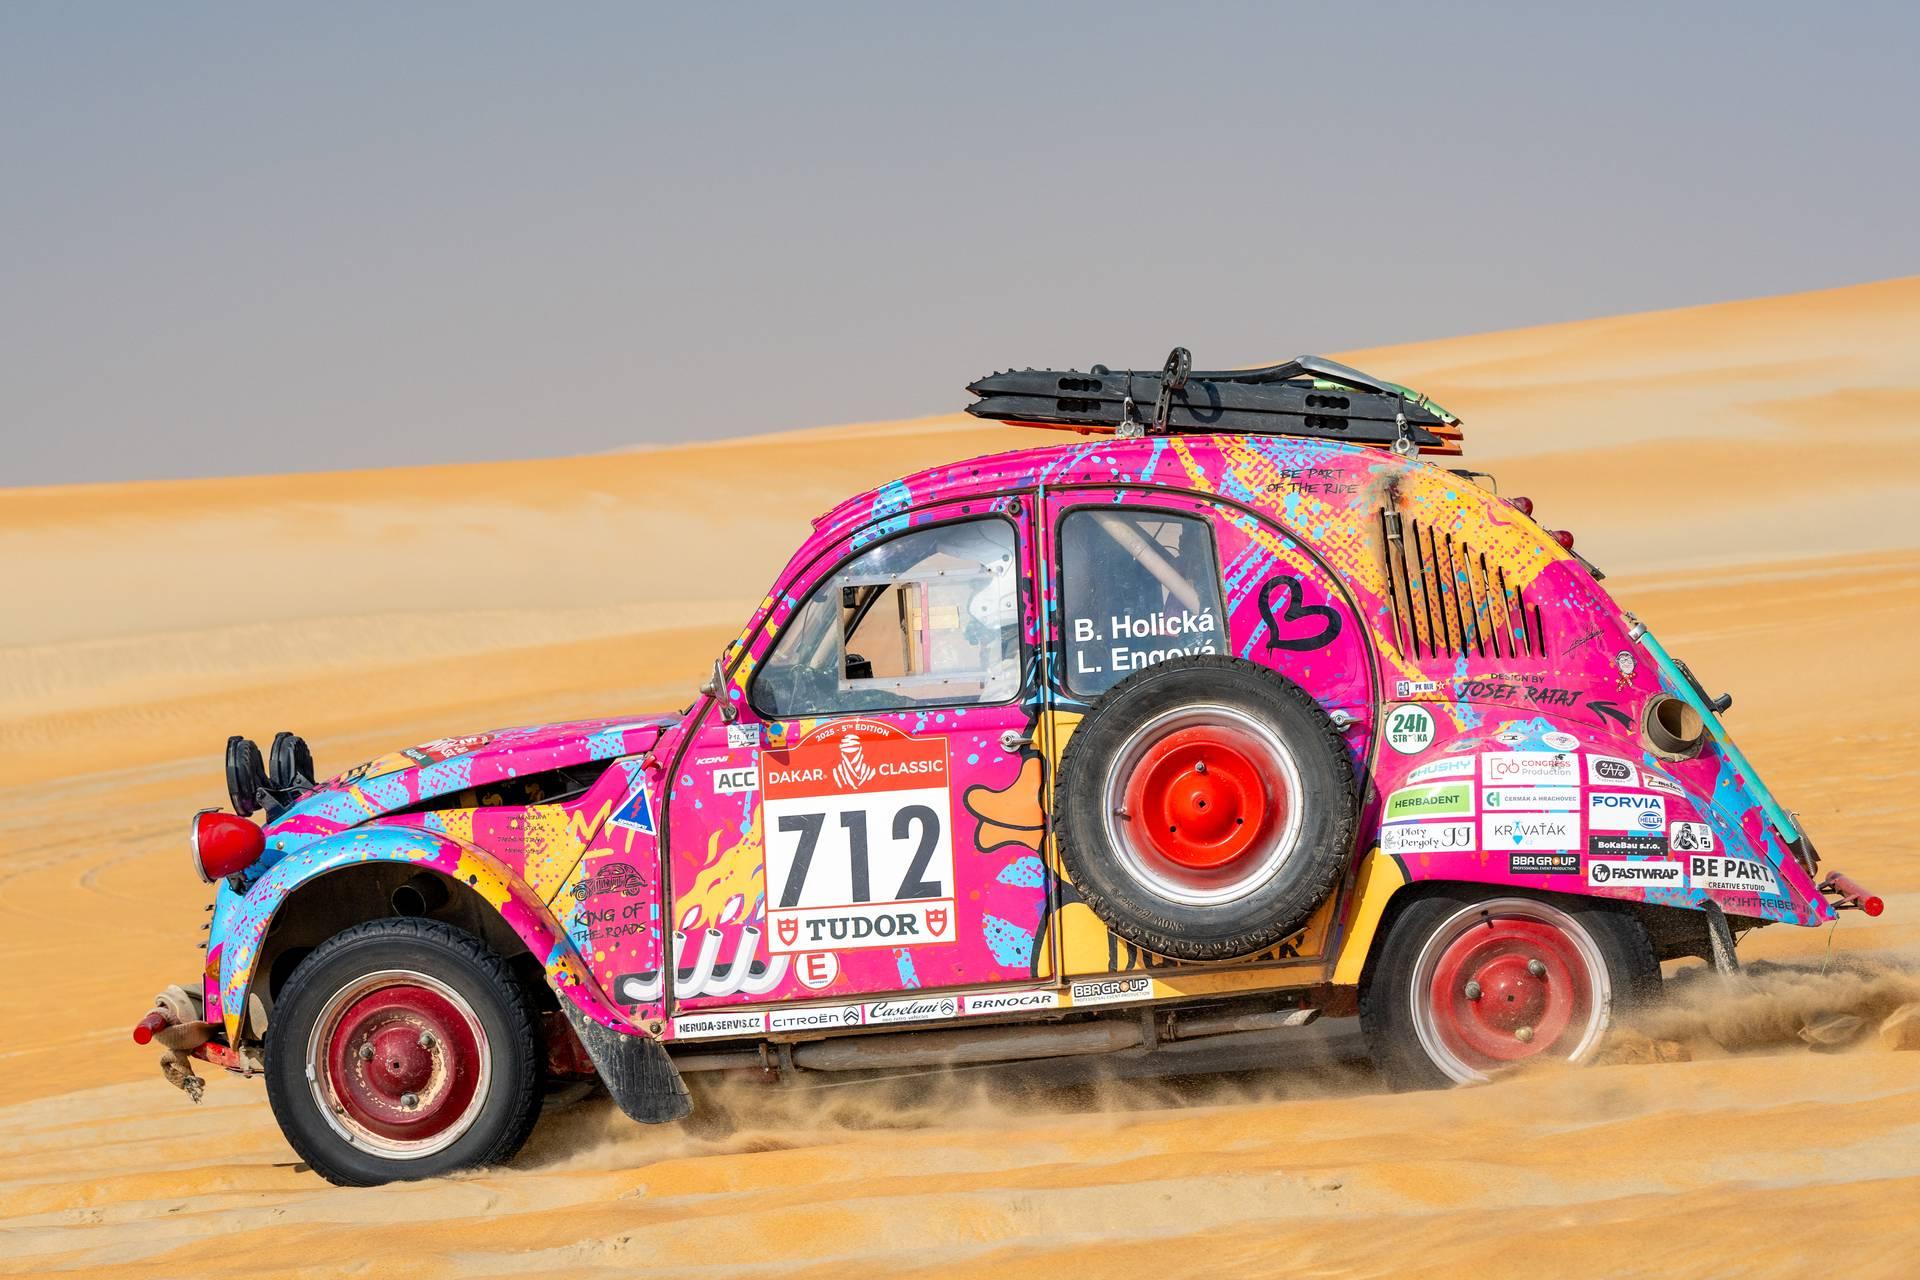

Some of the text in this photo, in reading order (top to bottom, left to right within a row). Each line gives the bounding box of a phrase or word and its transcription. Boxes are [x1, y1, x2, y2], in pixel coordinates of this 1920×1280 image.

[1280, 467, 1345, 480] BE PART
[1266, 482, 1361, 494] OF THE RIDE
[1074, 607, 1215, 642] B. Holická
[1077, 650, 1102, 674] L.
[1490, 673, 1545, 684] DESIGN BY
[1457, 680, 1584, 707] JOSEF RATAJ
[1393, 714, 1428, 733] 24h
[815, 728, 835, 742] 2025
[855, 723, 890, 737] EDITION
[769, 759, 944, 784] DAKAR CLASSIC
[1417, 760, 1471, 776] HUSKY
[1521, 760, 1571, 768] CONGRESS
[1521, 768, 1572, 776] Production
[718, 771, 756, 789] ACC
[1395, 795, 1460, 809] HERBADENT
[1592, 796, 1662, 809] FORVIA
[1598, 841, 1638, 849] BoKaBau
[778, 804, 942, 908] 712
[1612, 868, 1679, 880] FASTWRAP
[1692, 858, 1775, 883] BE PART.
[1708, 881, 1766, 891] CREATIVE STUDIO
[574, 901, 647, 927] KING OF
[606, 921, 647, 938] ROADS
[806, 913, 919, 941] TUDOR
[806, 953, 828, 981] E
[870, 1001, 939, 1018] Caselani
[972, 995, 1052, 1009] BRNOCAR
[679, 1018, 760, 1033] NERUDA-SERVIS.CZ
